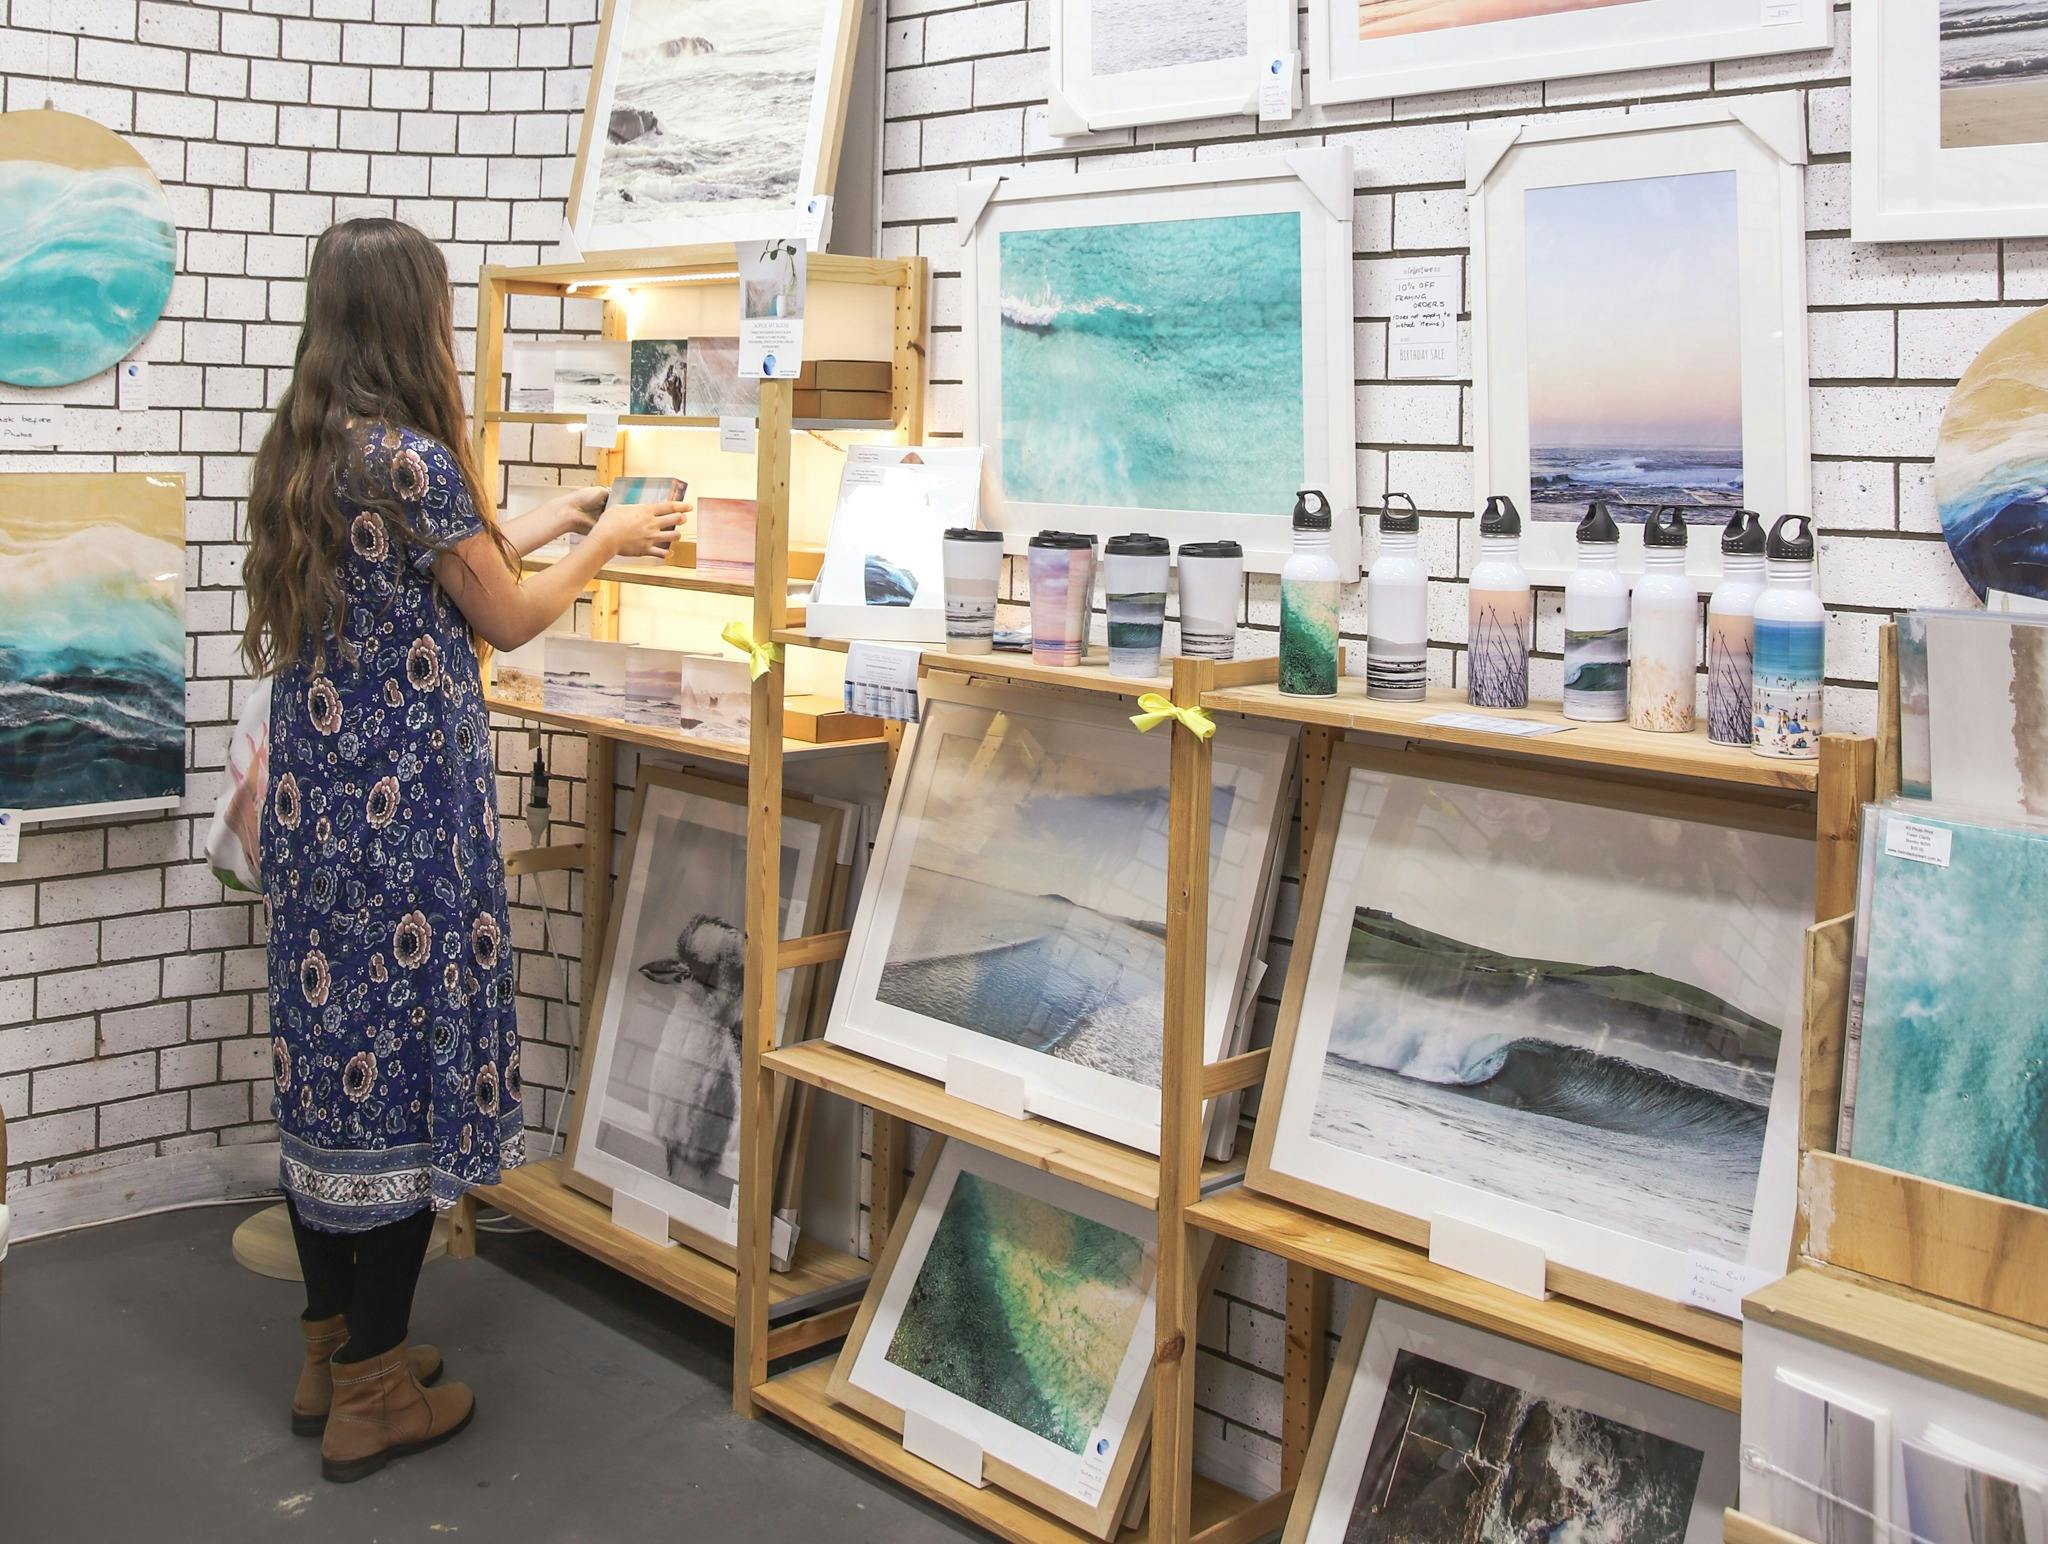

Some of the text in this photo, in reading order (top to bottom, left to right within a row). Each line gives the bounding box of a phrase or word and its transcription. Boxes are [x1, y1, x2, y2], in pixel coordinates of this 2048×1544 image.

[1398, 281, 1436, 292] 10% OFF
[1394, 293, 1427, 302] FRAMING
[1412, 301, 1446, 309] ORDERS
[1422, 312, 1441, 320] apply
[1400, 347, 1445, 361] BIRTHDAY SALE
[21, 415, 52, 424] before
